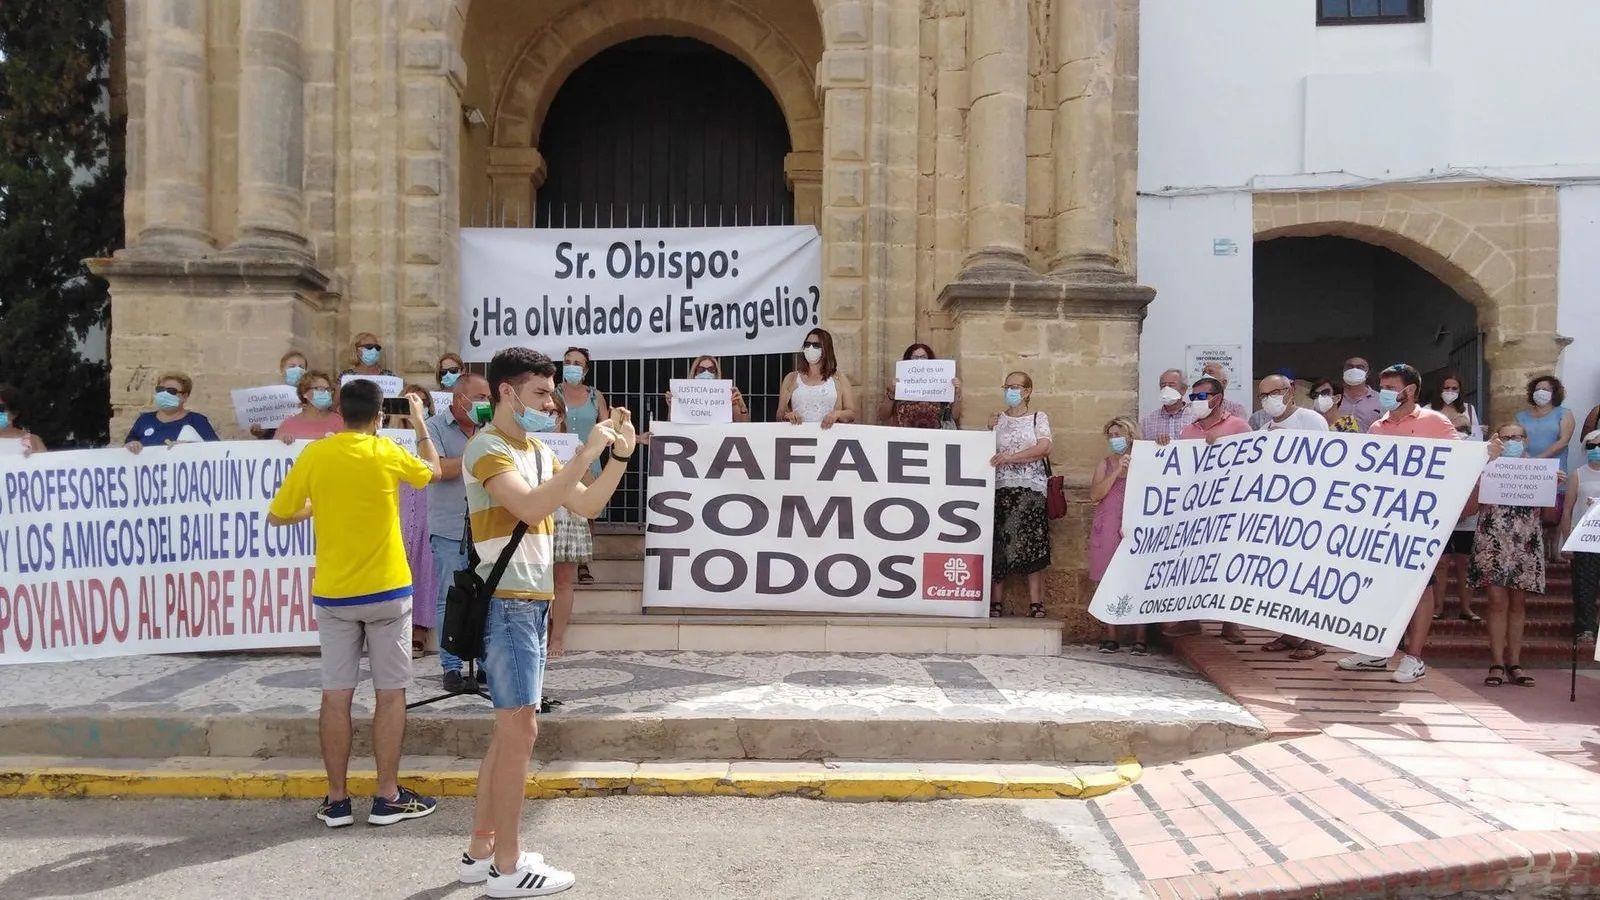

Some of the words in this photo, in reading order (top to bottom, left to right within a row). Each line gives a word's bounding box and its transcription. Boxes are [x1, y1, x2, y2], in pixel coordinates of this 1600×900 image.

[554, 242, 596, 279] Sr.
[606, 240, 739, 289] Obispo:
[469, 297, 517, 347] ¿Ha
[525, 294, 642, 337] olvidado
[649, 294, 672, 333] el
[680, 285, 821, 340] Evangelio?
[908, 366, 925, 374] ¿Qué
[922, 388, 947, 396] pastor?
[246, 405, 273, 413] rebaño
[248, 393, 267, 403] ¿Qué
[690, 409, 713, 417] CONIL
[5, 466, 129, 514] PROFESORES
[133, 464, 167, 508] JOSE
[170, 450, 242, 507] JOAQUÍN
[246, 458, 257, 500] Y
[648, 434, 987, 488] RAFAEL
[1155, 446, 1182, 476] “A
[1193, 435, 1268, 475] VECES
[1272, 435, 1348, 468] UNO
[1355, 441, 1452, 480] SABE
[646, 490, 982, 544] SOMOS
[1143, 486, 1181, 516] DE
[1182, 469, 1230, 512] QUÉ
[1230, 473, 1317, 506] LADO
[1323, 480, 1440, 531] ESTAR,
[0, 529, 9, 572] Y
[16, 523, 56, 573] LOS
[62, 518, 145, 569] AMIGOS
[148, 516, 176, 564] DEL
[180, 512, 230, 561] BAILE
[235, 511, 260, 559] DE
[1129, 512, 1237, 555] SIMPLEMENTE
[1237, 512, 1322, 551] VIENDO
[1326, 522, 1441, 571] QUIÉNES
[645, 547, 917, 600] TODOS
[927, 586, 982, 598] Cáritas
[1144, 550, 1191, 591] ESTÁN
[1190, 552, 1222, 585] DEL
[1225, 552, 1288, 590] OTRO
[1288, 562, 1374, 605] LADO”
[138, 575, 161, 640] AL
[165, 569, 236, 639] PADRE
[1139, 596, 1187, 615] CONSEJO
[1186, 593, 1226, 610] LOCAL
[1230, 595, 1255, 614] DE
